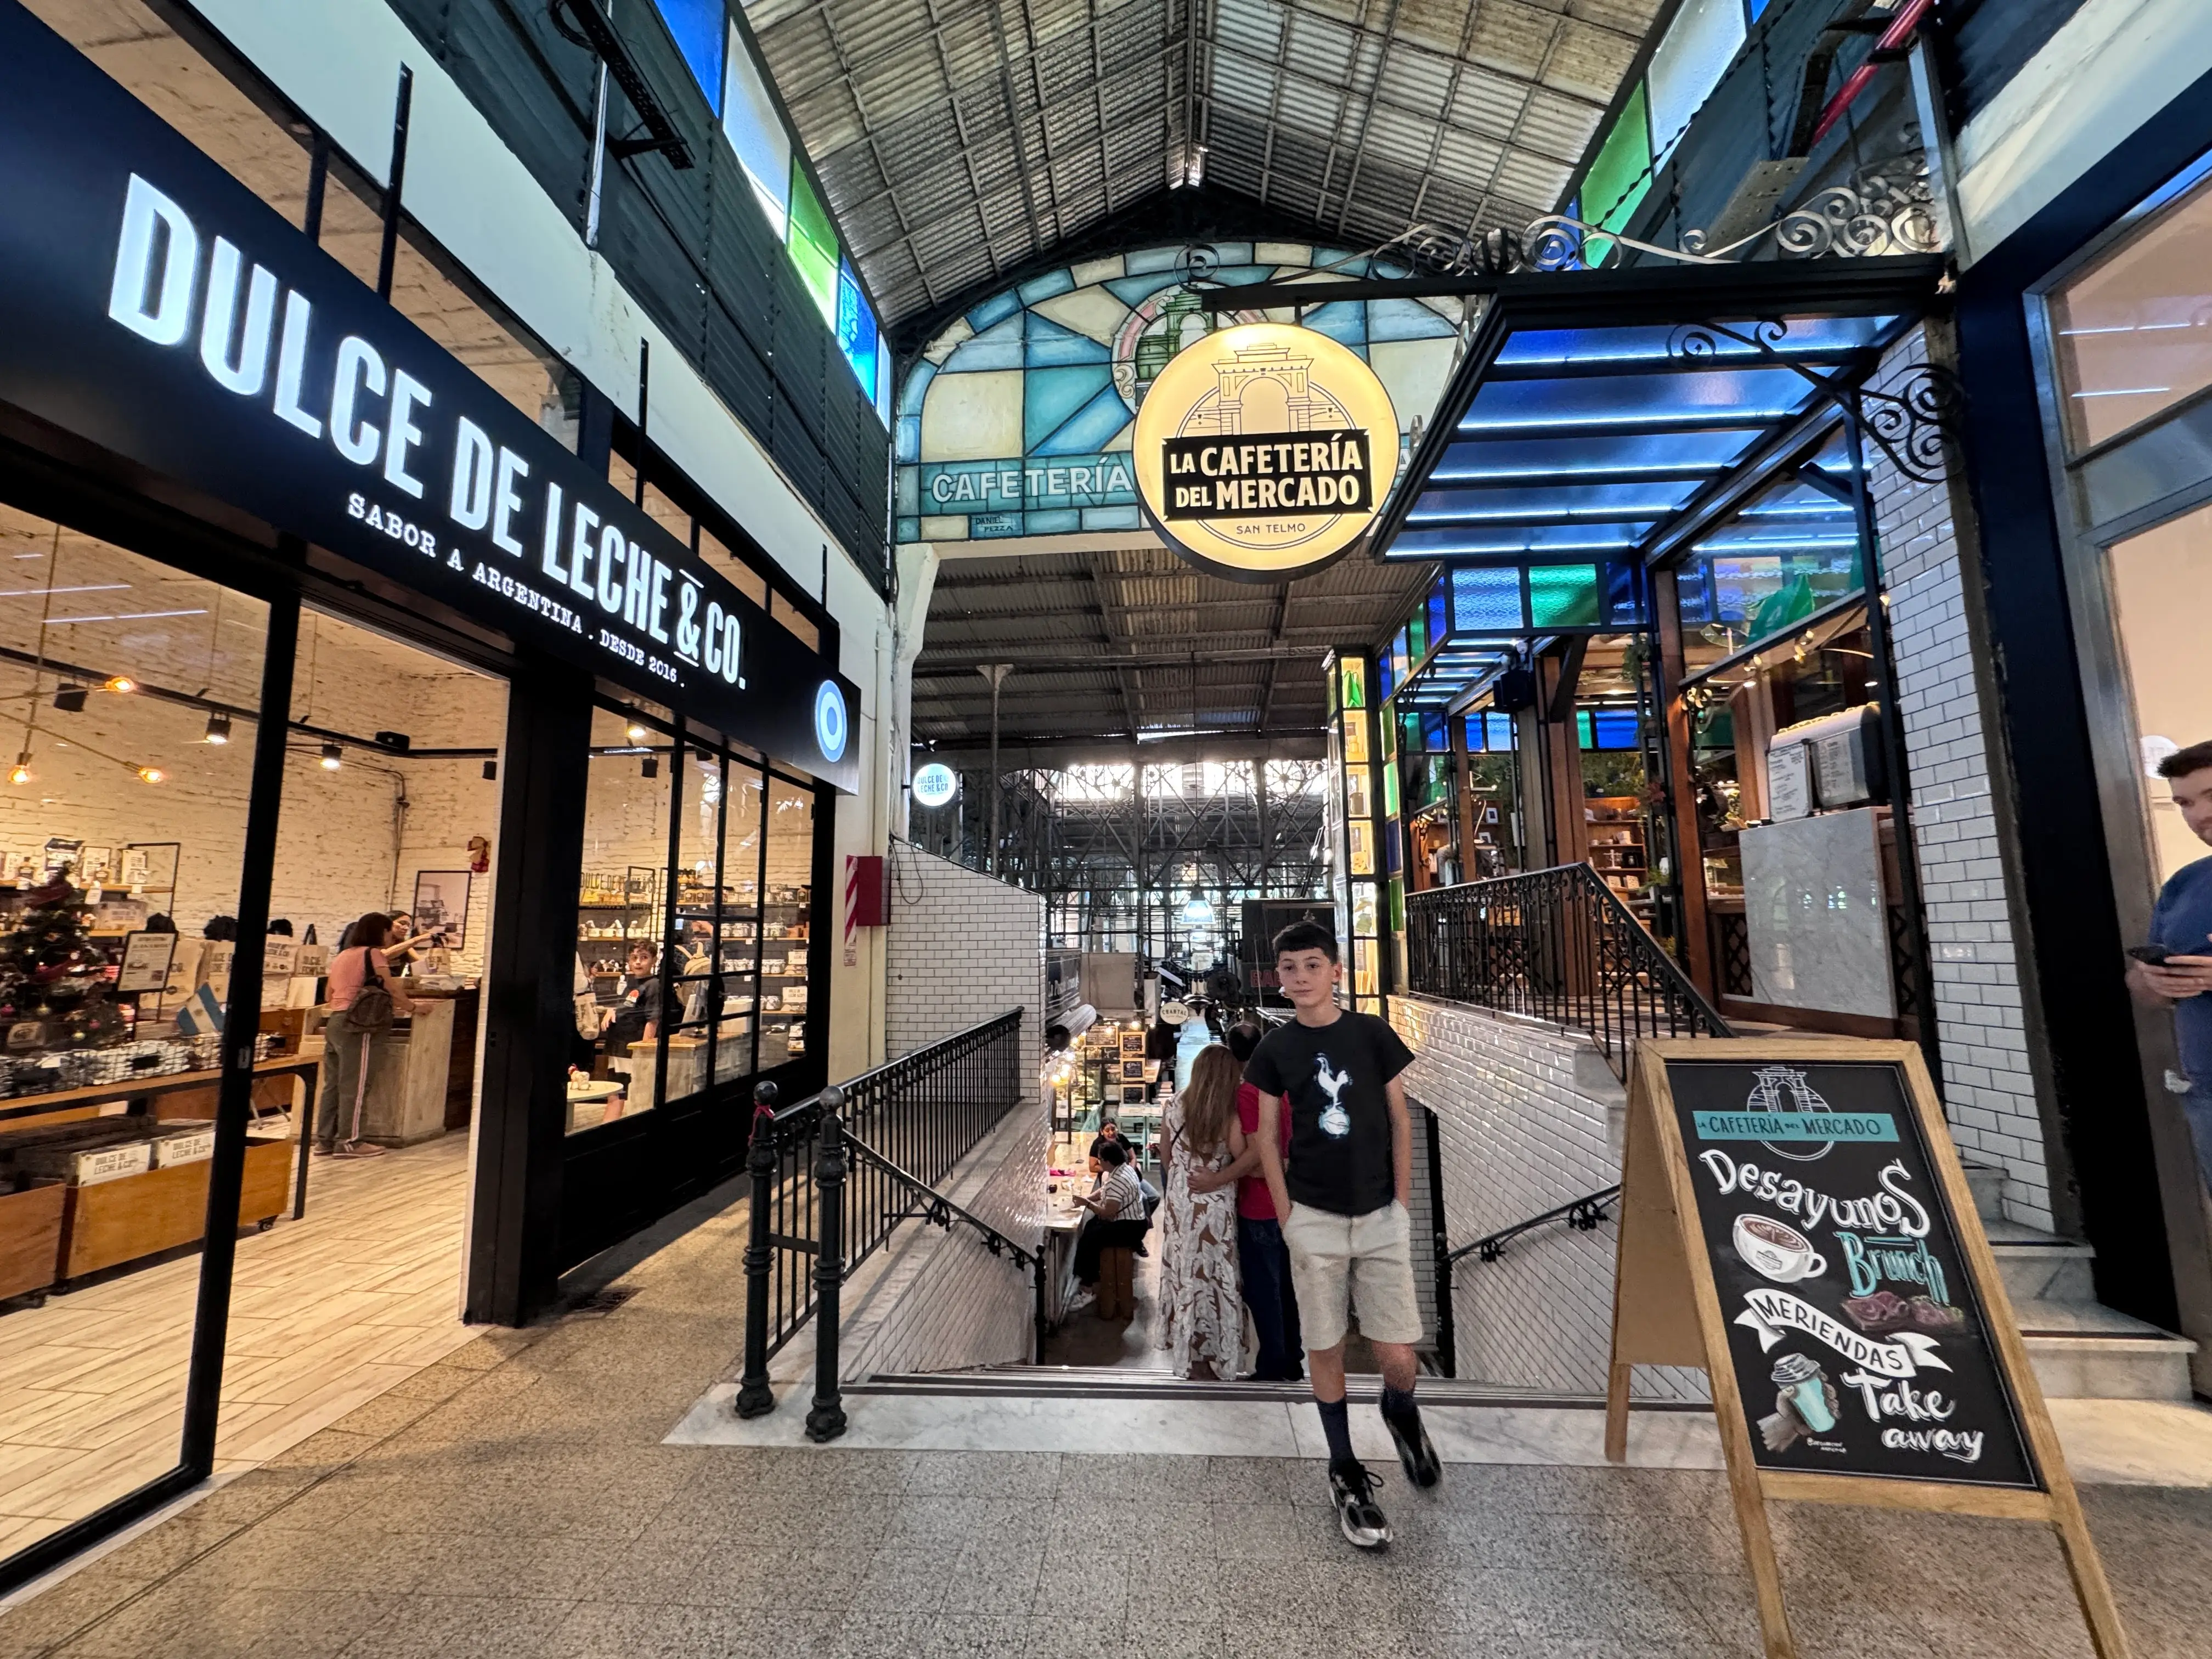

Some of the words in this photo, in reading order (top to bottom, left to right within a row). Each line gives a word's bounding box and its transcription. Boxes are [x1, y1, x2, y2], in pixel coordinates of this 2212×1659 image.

[109, 172, 432, 499] DULCE
[450, 416, 529, 558] DE
[542, 482, 673, 645] LECHE
[1170, 453, 1195, 475] LA
[1200, 433, 1363, 477] CAFETERÍA
[932, 456, 1133, 503] CAFETERÍA
[1175, 486, 1212, 507] DEL
[1216, 474, 1359, 510] MERCADO
[975, 516, 1003, 525] DANIEL
[1235, 524, 1260, 535] SAN
[1266, 523, 1306, 534] TELMO
[347, 492, 437, 558] SABOR
[446, 548, 465, 572] A
[471, 561, 583, 634] ARGENTINA
[599, 628, 646, 667] DESDE
[917, 776, 935, 785] DULCE
[935, 775, 943, 783] DE
[1801, 1118, 1881, 1136] MERCADO
[1832, 1231, 1950, 1306] Brunch
[1753, 1294, 1903, 1370] MERIENDAS
[1839, 1367, 1955, 1423] Take
[1881, 1427, 1984, 1464] away
